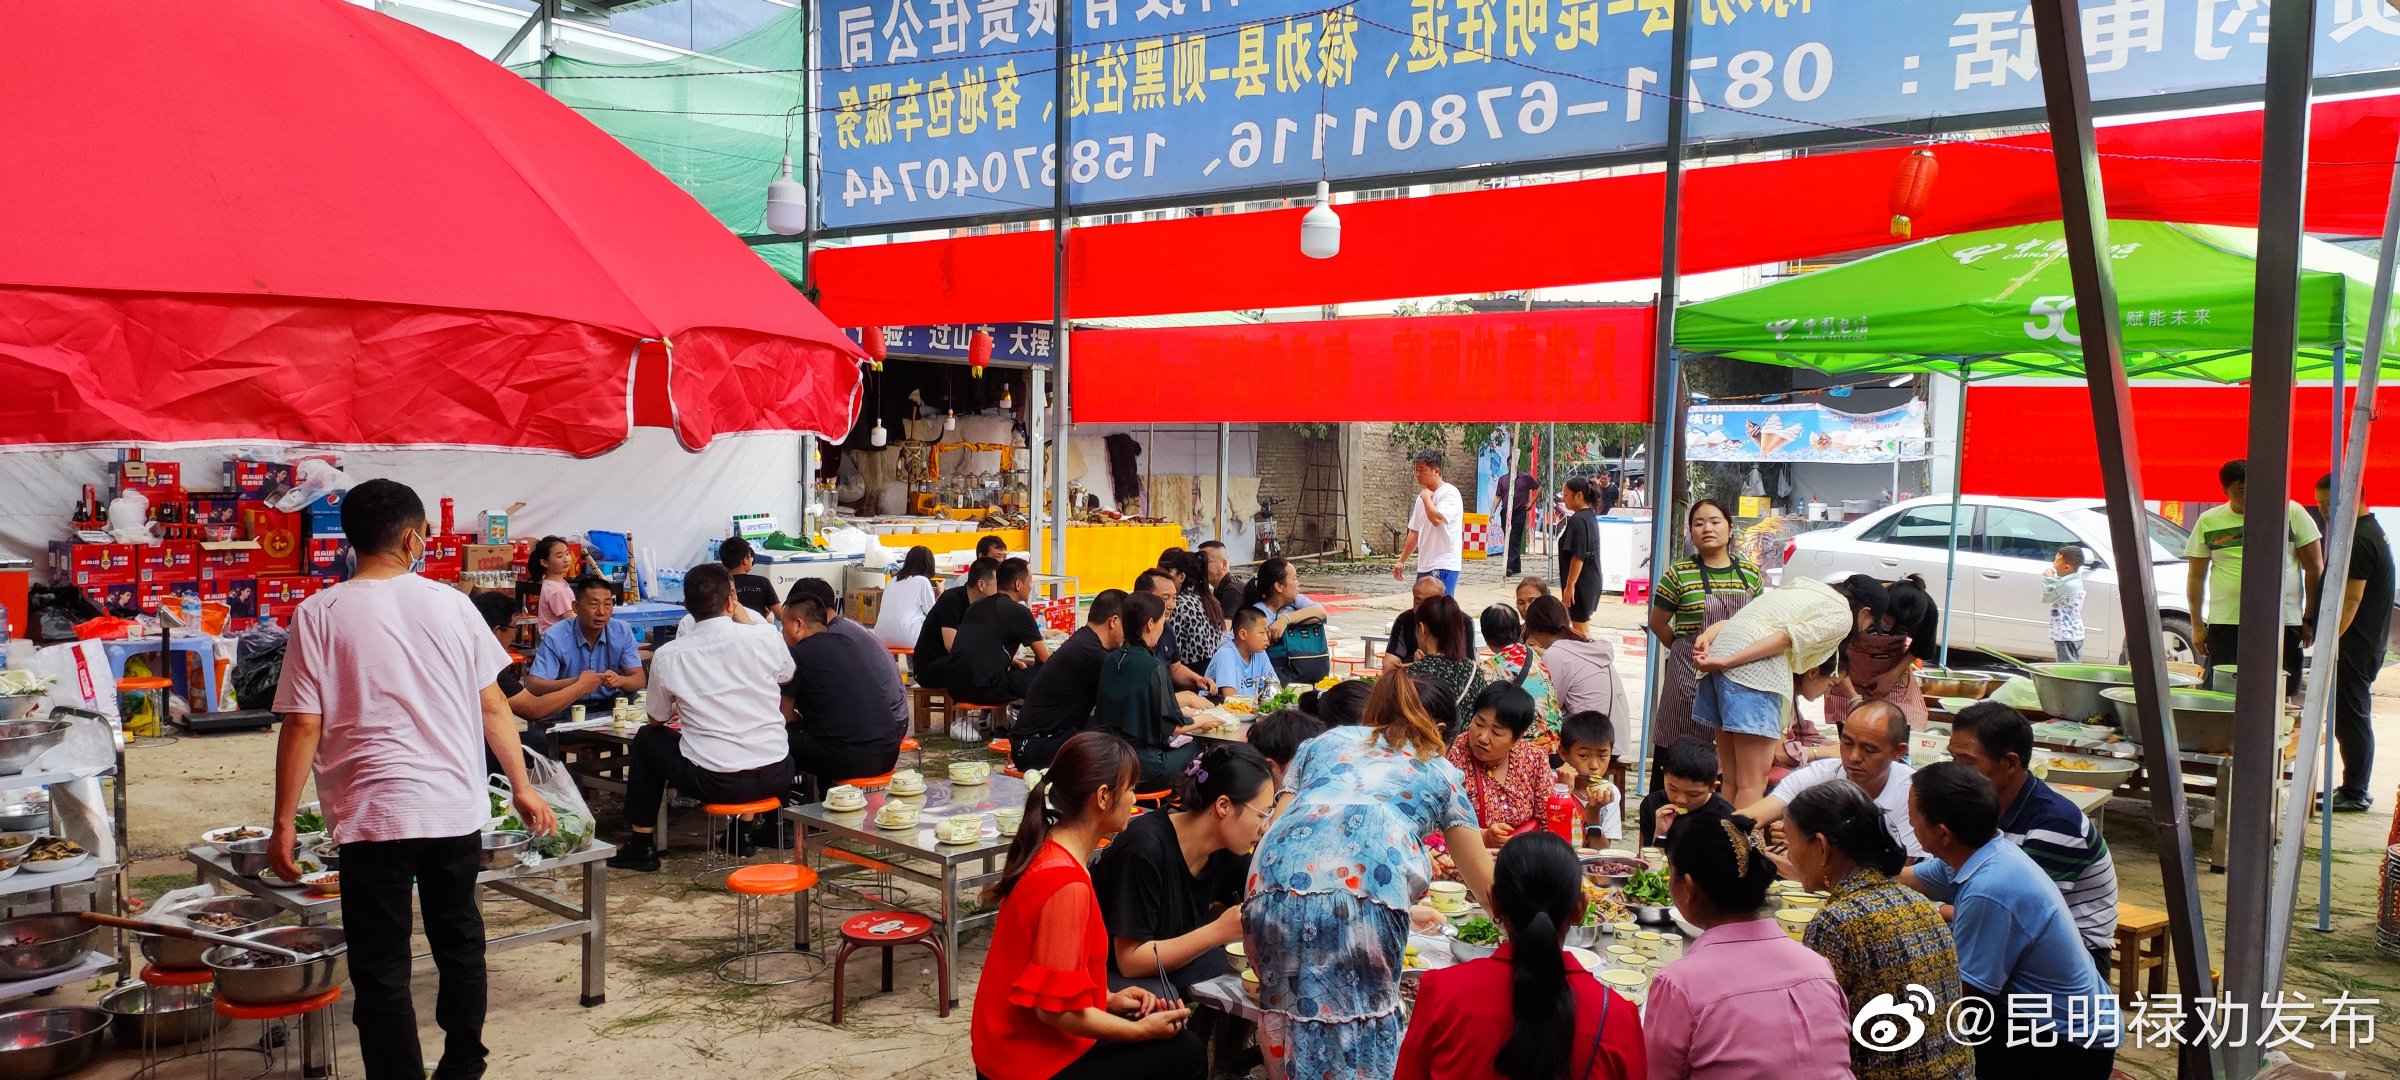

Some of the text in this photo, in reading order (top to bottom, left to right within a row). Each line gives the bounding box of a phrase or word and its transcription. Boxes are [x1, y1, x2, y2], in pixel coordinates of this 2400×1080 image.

[1802, 315, 1869, 335] 中国电信
[2126, 308, 2211, 327] 赋能未来
